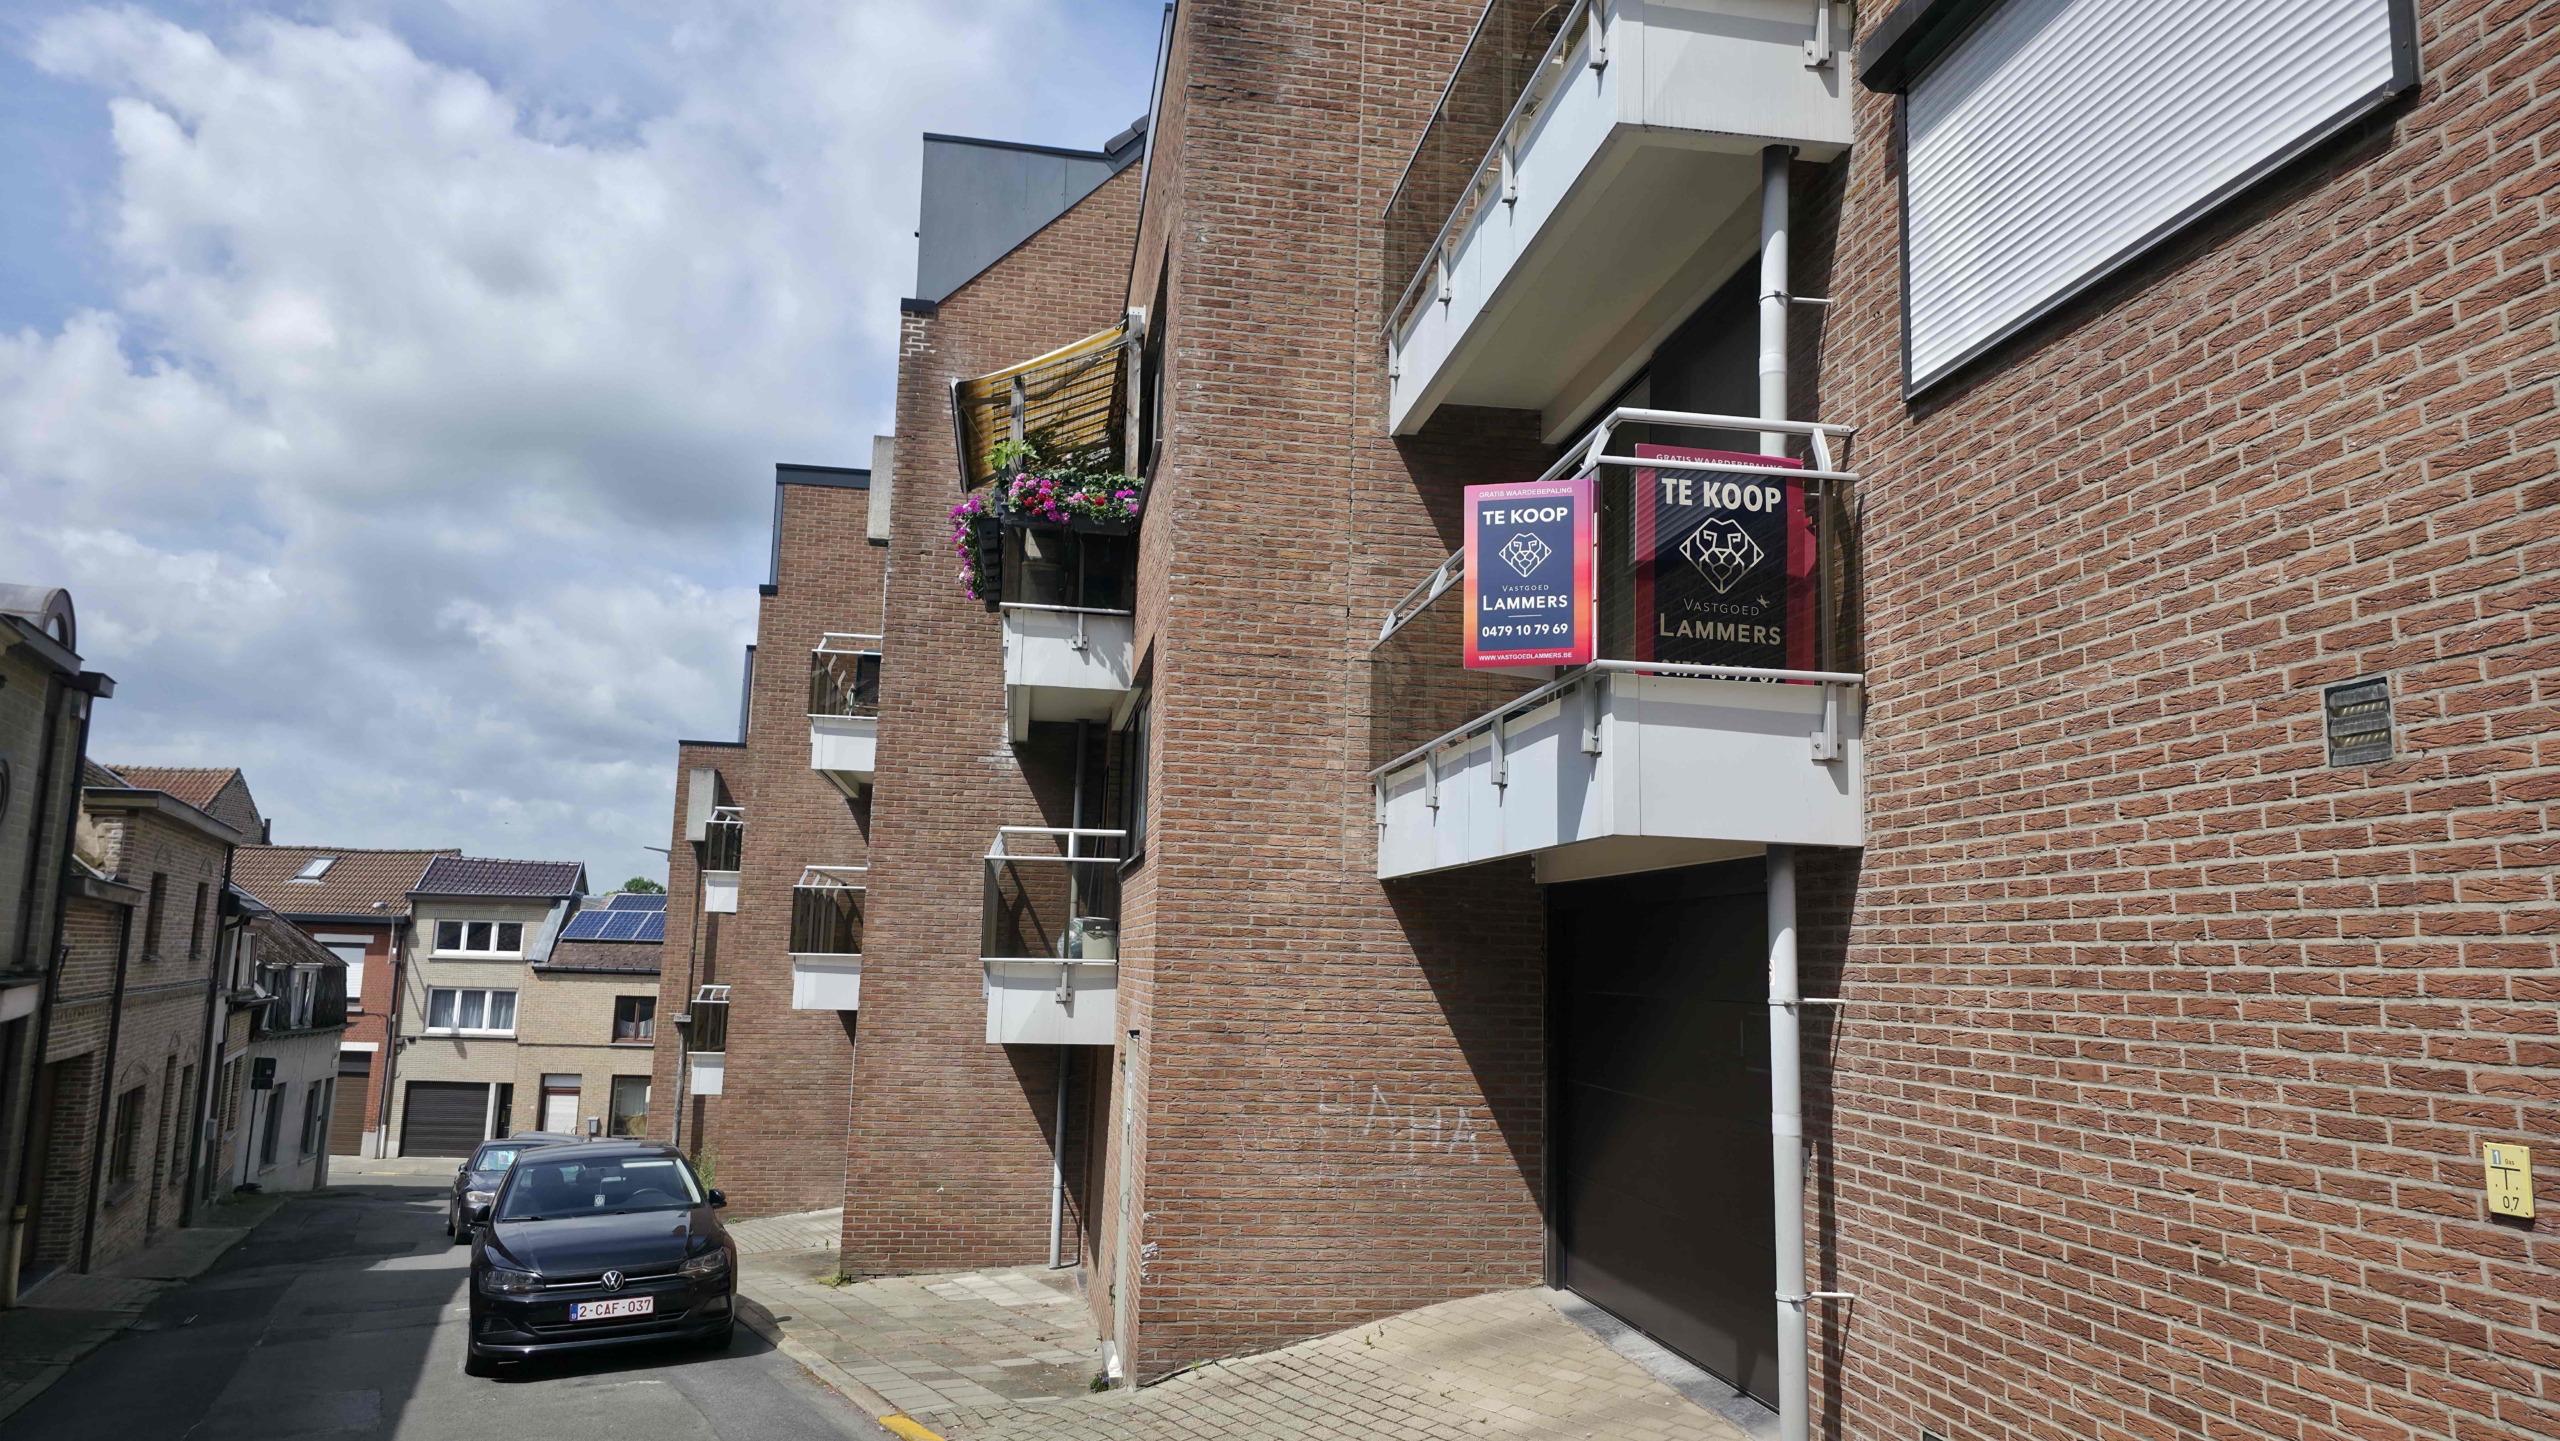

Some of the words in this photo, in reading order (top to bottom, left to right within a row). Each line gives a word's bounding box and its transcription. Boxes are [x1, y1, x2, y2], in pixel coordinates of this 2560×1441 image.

[1479, 490, 1505, 498] GRATIS
[1506, 487, 1573, 497] WAARDEBEPALING
[1661, 477, 1693, 506] TE
[1703, 480, 1782, 513] KOOP
[1482, 510, 1505, 526] TE
[1510, 507, 1568, 524] KOOP
[1482, 625, 1513, 638] 0479
[1516, 624, 1531, 636] 10
[1534, 623, 1550, 635] 79
[1552, 622, 1569, 635] 69
[1479, 652, 1573, 661] WWW.VASTGOEDLAMMERS.BE
